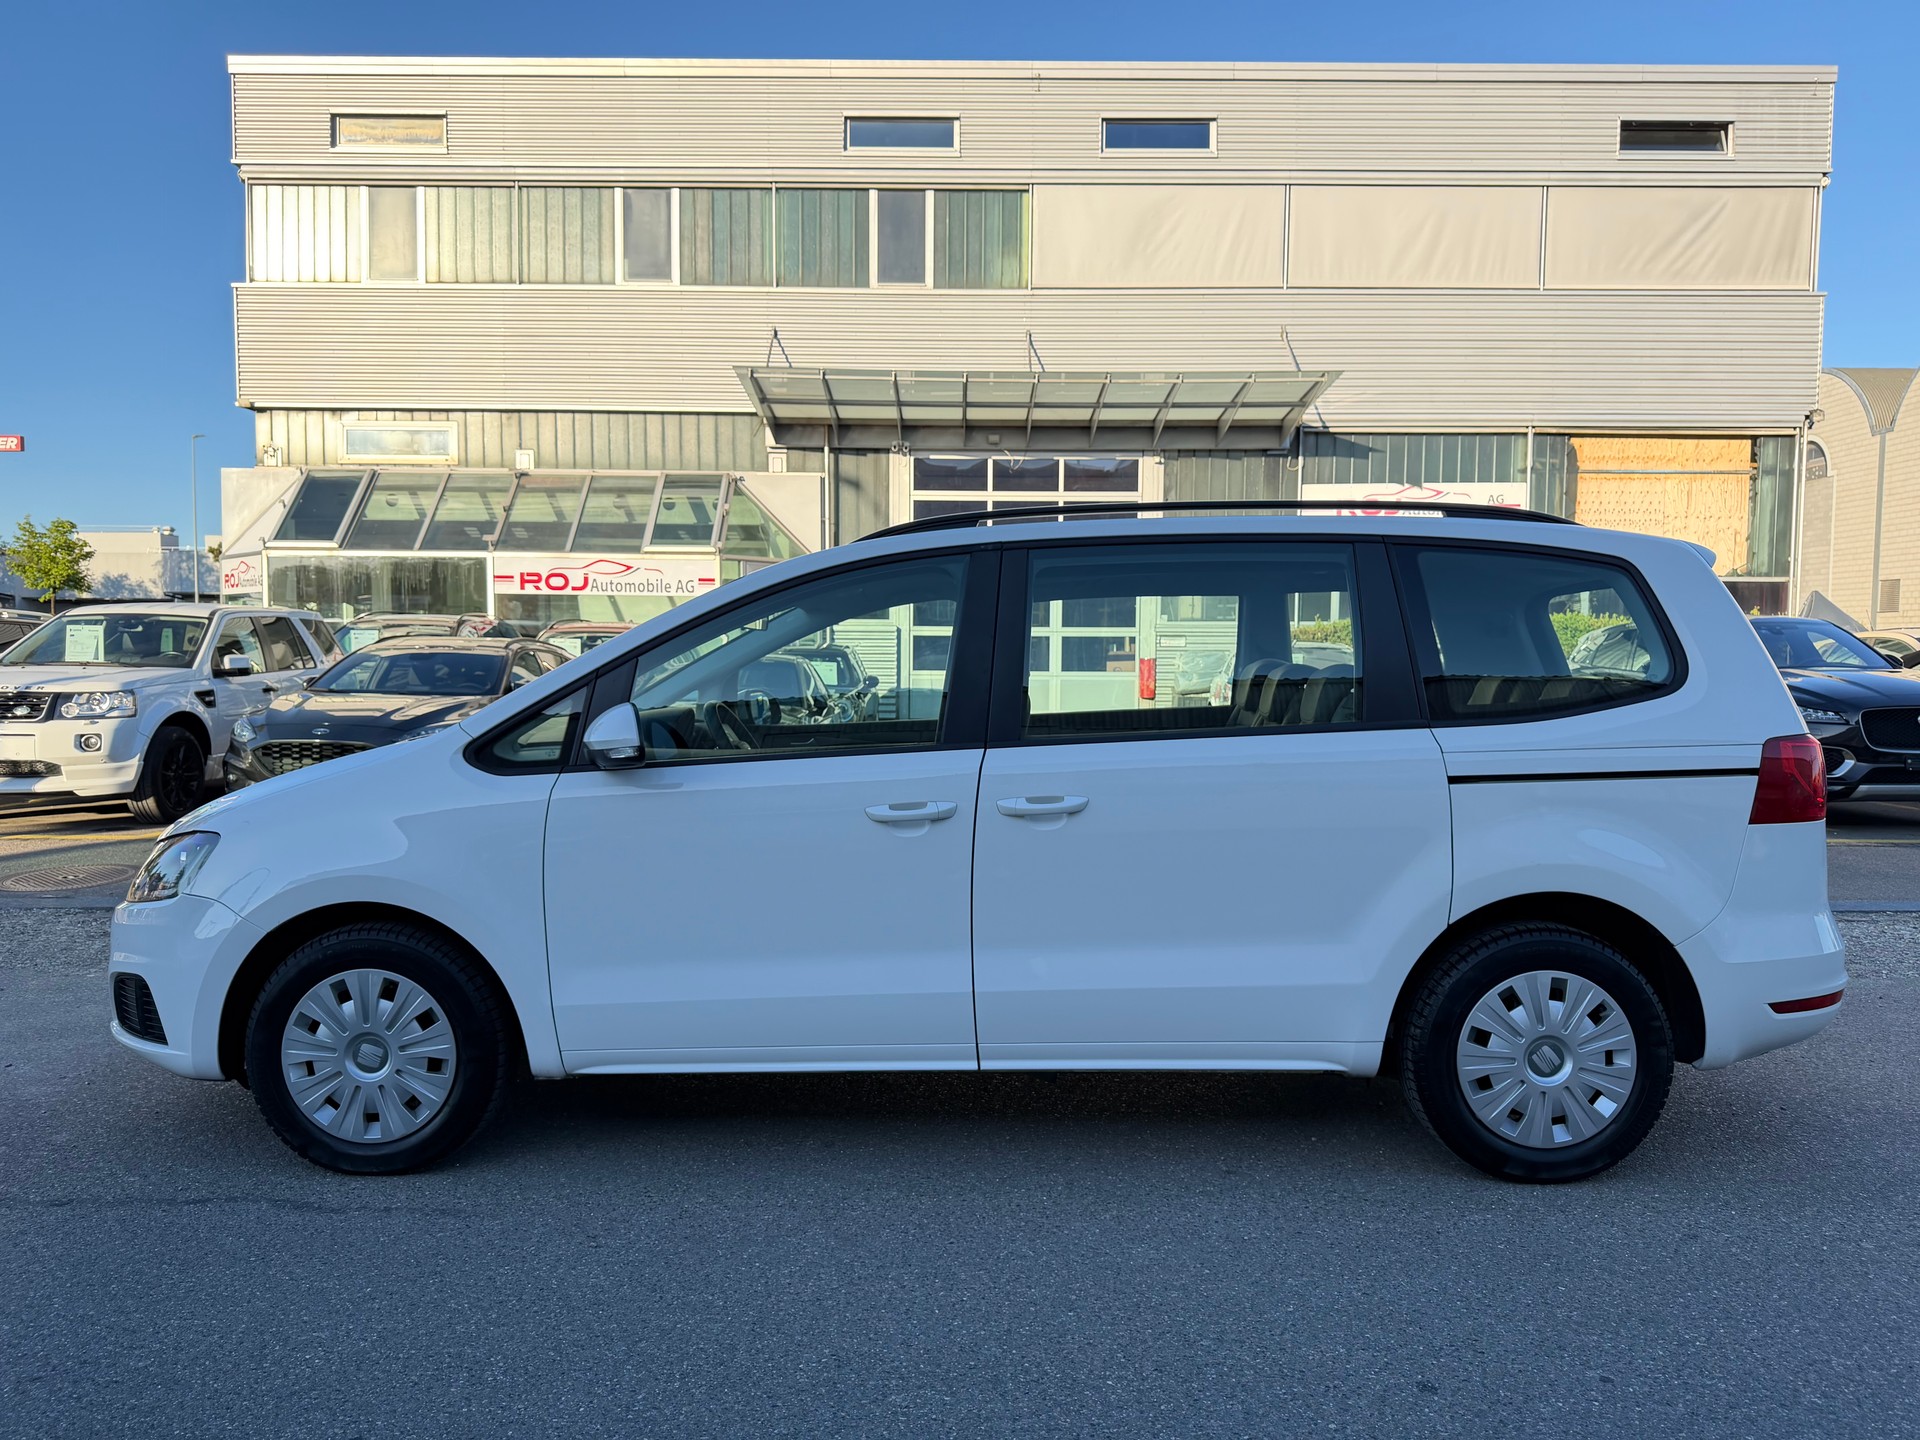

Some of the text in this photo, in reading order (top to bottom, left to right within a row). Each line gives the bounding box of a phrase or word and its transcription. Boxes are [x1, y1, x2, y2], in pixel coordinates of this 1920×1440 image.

[224, 572, 239, 589] ROJ
[519, 572, 695, 593] ROJ Automobile AG
